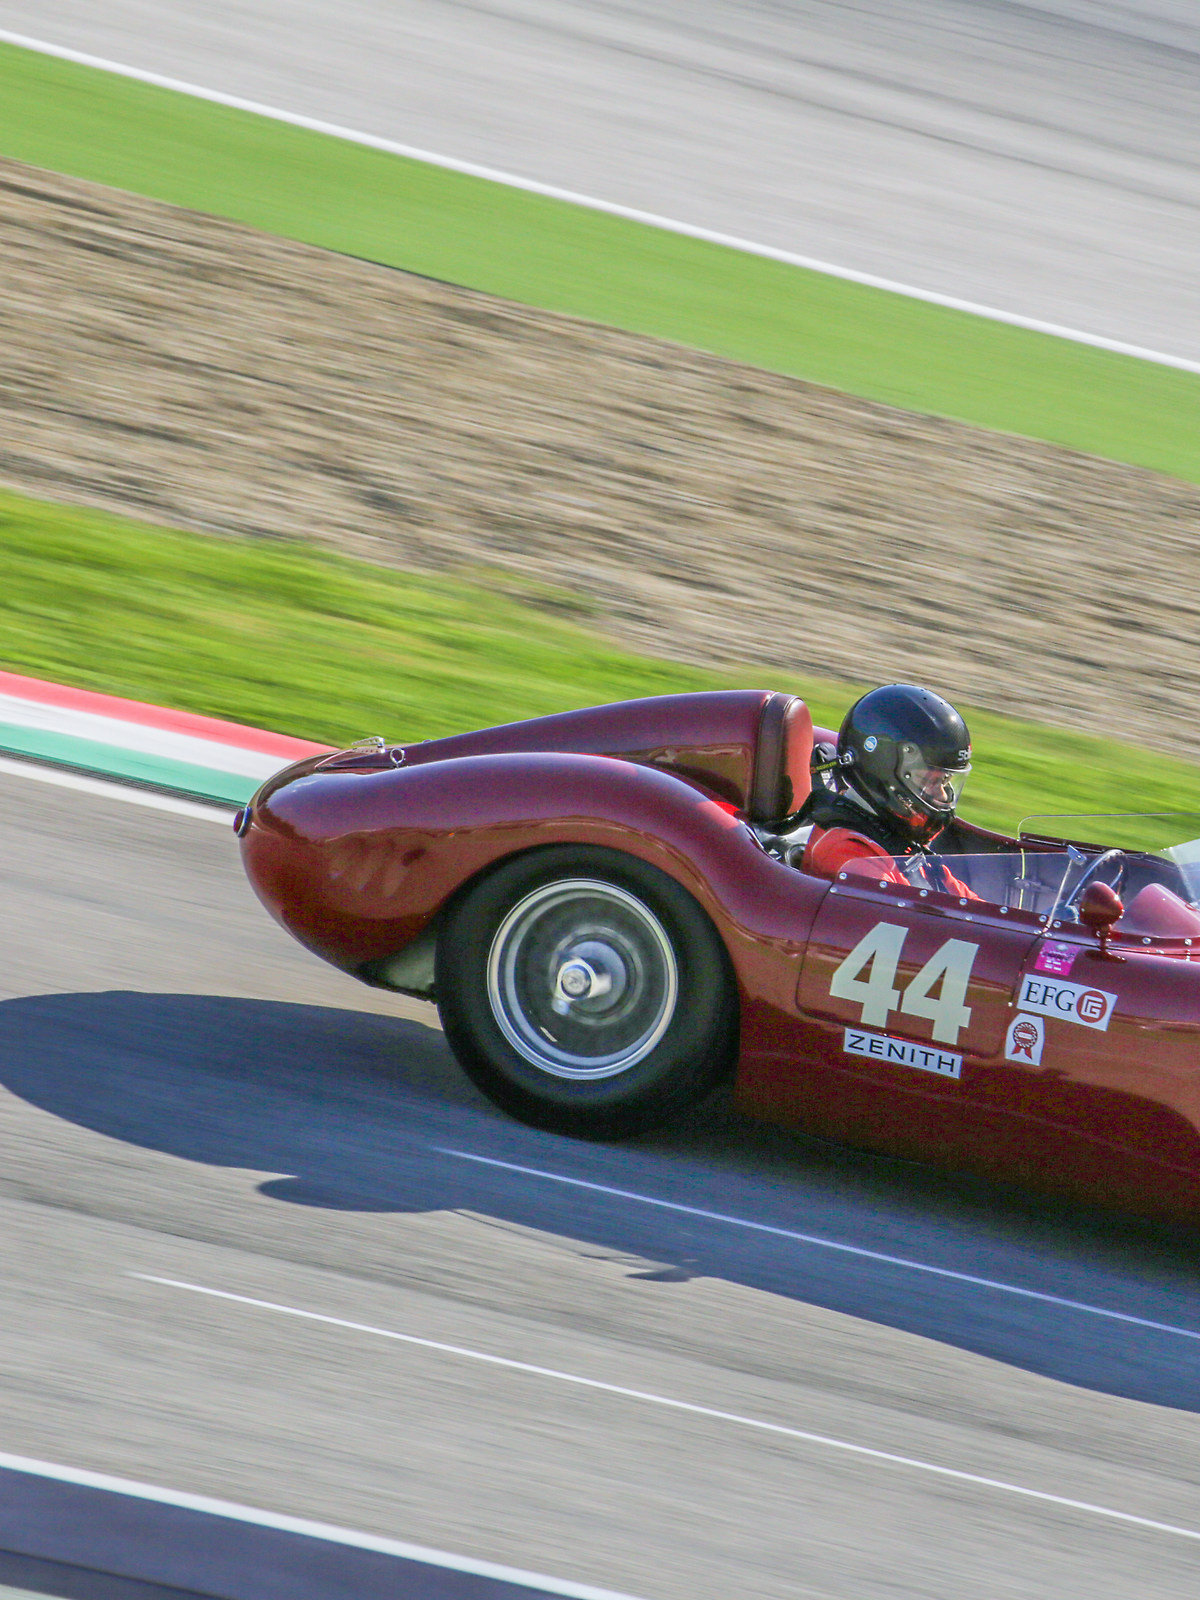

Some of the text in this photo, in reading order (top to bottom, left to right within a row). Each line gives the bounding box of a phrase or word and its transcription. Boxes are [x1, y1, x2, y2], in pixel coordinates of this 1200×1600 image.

[830, 922, 979, 1044] 44
[1023, 980, 1075, 1011] EFG
[848, 1033, 955, 1072] ZENITH
